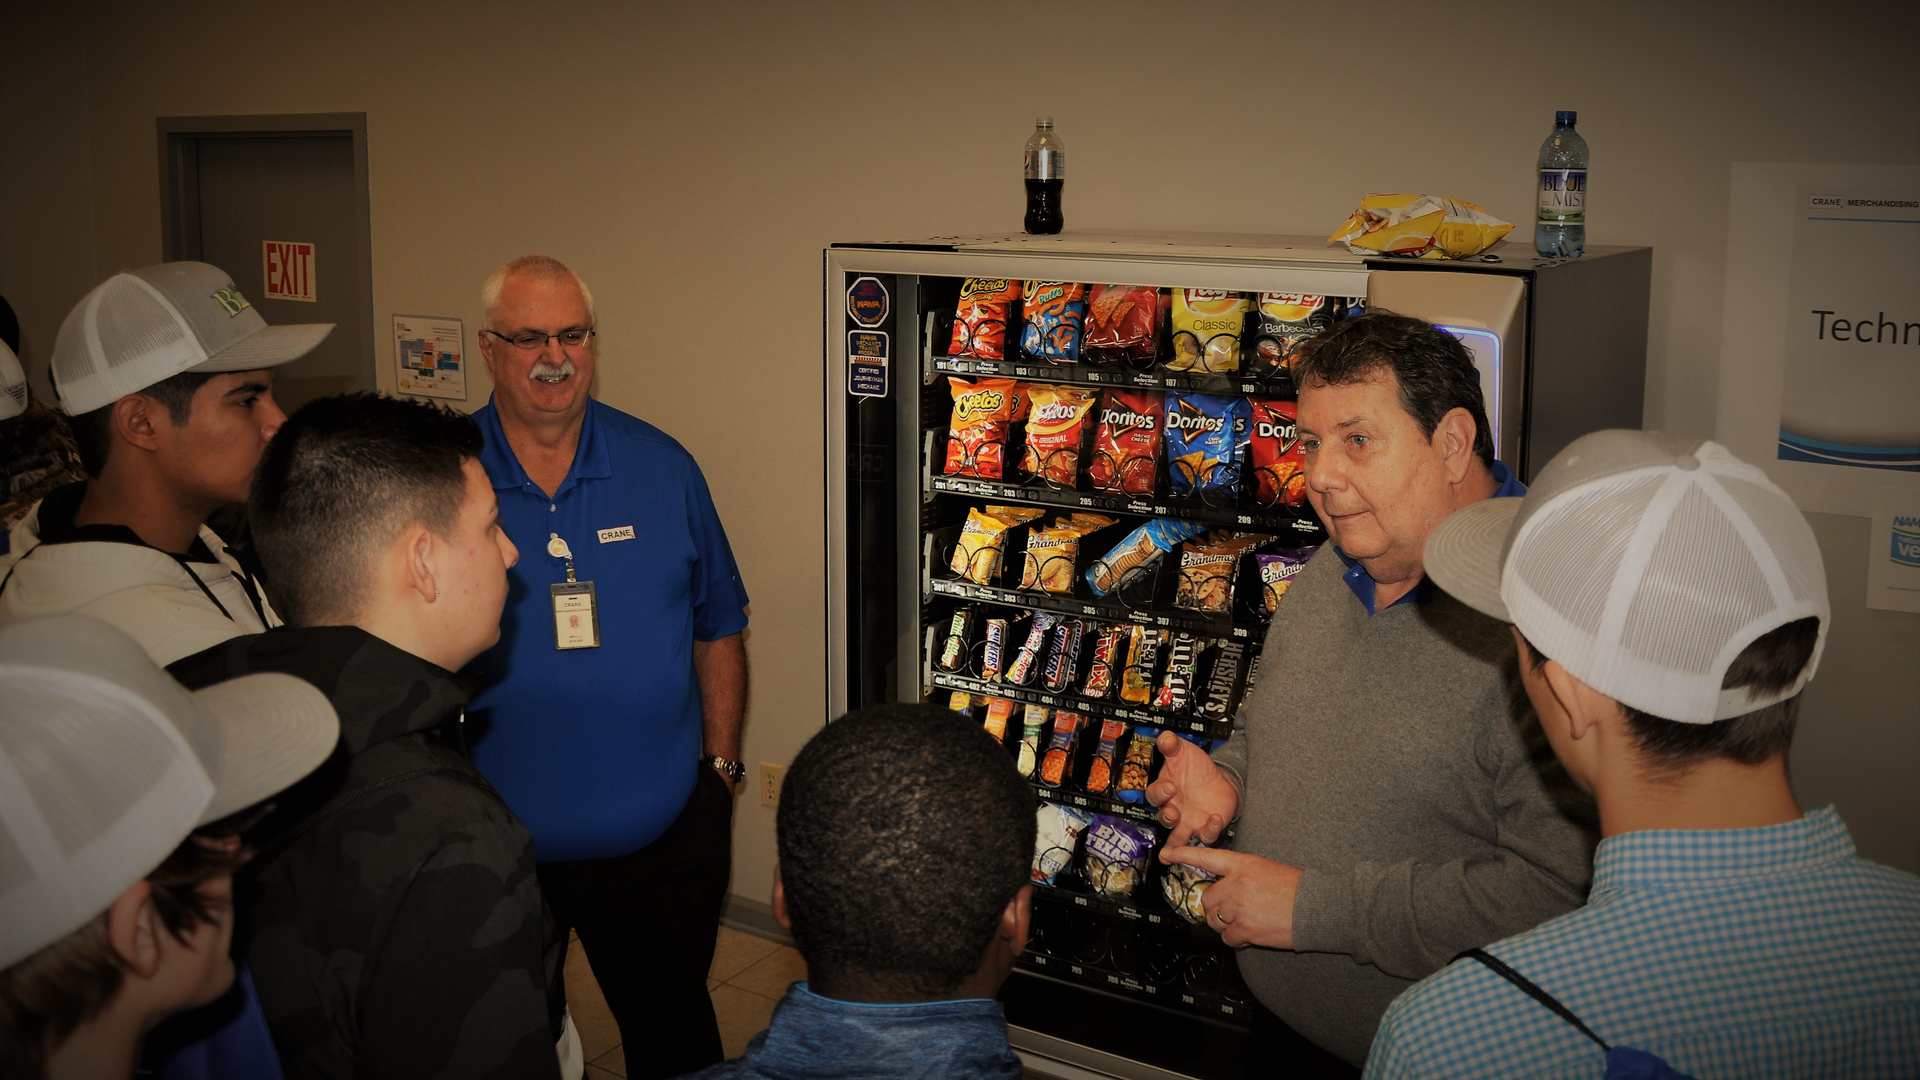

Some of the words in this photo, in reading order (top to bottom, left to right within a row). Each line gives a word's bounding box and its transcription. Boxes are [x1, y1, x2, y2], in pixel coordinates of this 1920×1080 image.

[1544, 175, 1584, 191] BLUE
[1552, 192, 1585, 206] MIST
[1812, 198, 1841, 206] CRANE
[1847, 199, 1919, 208] MERCHANDISING
[267, 243, 310, 296] EXIT
[1038, 287, 1064, 305] Puffs
[1193, 319, 1236, 331] Classic
[1812, 310, 1920, 345] Techn
[937, 361, 947, 370] 101
[1016, 367, 1027, 375] 103
[1088, 373, 1099, 381] 105
[1165, 378, 1177, 387] 107
[1241, 384, 1255, 393] 109
[955, 390, 1002, 419] Cheetos
[1100, 409, 1154, 429] Doritos
[1167, 411, 1225, 432] Doritos
[1258, 422, 1297, 438] Dori
[1004, 489, 1016, 497] 203
[1080, 497, 1092, 506] 205
[1154, 506, 1167, 514] 207
[1237, 515, 1252, 524] 209
[600, 529, 632, 541] CRANE
[1181, 552, 1236, 567] Grandma's
[1083, 606, 1096, 615] 305
[1157, 616, 1170, 626] 307
[1233, 628, 1248, 638] 309
[1090, 633, 1118, 687] TWIX
[1204, 641, 1245, 713] HERSHEY'S
[1041, 695, 1053, 704] 404
[1077, 703, 1090, 711] 405
[1115, 708, 1128, 718] 406
[1153, 716, 1165, 725] 407
[1038, 790, 1051, 799] 504
[1074, 796, 1087, 806] 505
[1111, 804, 1125, 814] 506
[1096, 824, 1132, 853] BIG
[1086, 833, 1133, 867] TEXAS
[1145, 984, 1157, 994] 707
